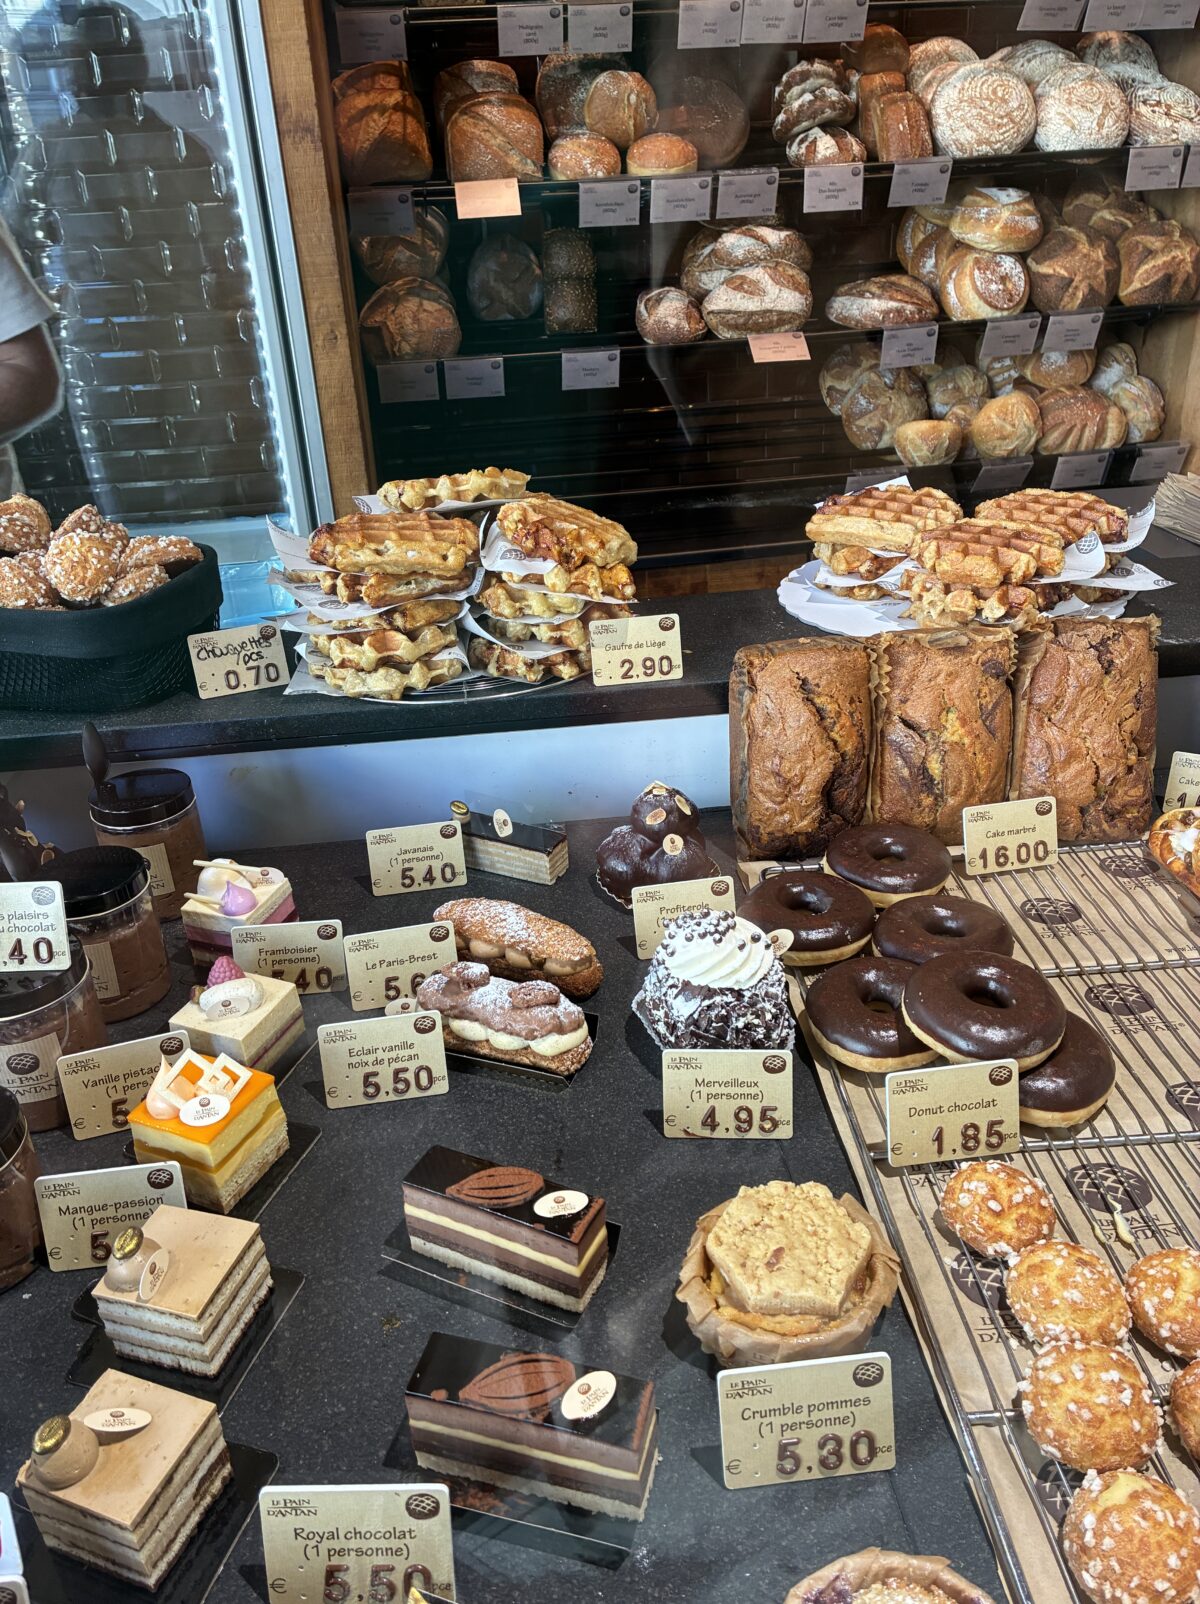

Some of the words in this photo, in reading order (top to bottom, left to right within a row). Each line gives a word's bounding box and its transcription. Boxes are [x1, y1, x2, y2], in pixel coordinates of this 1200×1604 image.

[605, 642, 632, 652] Gaufre
[646, 640, 666, 648] Liège
[620, 655, 672, 680] 2,90
[224, 662, 279, 690] 0,70
[1179, 777, 1200, 786] Cake
[986, 829, 1005, 838] Cake
[1007, 825, 1036, 836] marbré
[397, 844, 434, 856] Javanais
[979, 840, 1048, 868] 16,00
[389, 858, 398, 868] (1
[402, 852, 444, 866] personne)
[401, 862, 456, 888] 5,40
[660, 902, 710, 914] Profiterole
[8, 910, 48, 924] plaisirs
[8, 922, 56, 932] chocolat
[258, 946, 317, 956] Framboisier
[258, 959, 268, 968] (1
[272, 954, 320, 967] personne)
[366, 962, 376, 970] Le
[379, 952, 438, 968] Paris-Brest
[348, 1046, 380, 1058] Eclair
[382, 1041, 414, 1053] vanille
[348, 1060, 369, 1070] noix
[372, 1057, 384, 1066] de
[388, 1053, 419, 1068] pécan
[19, 1072, 48, 1084] PAIN
[82, 1074, 120, 1088] Vanille
[328, 1087, 338, 1098] €
[362, 1065, 433, 1098] 5,50
[433, 1075, 446, 1084] pce
[695, 1078, 758, 1088] Merveilleux
[904, 1078, 924, 1086] PAIN
[106, 1086, 118, 1098] (1
[690, 1090, 702, 1102] (1
[707, 1090, 764, 1102] personne)
[909, 1106, 944, 1117] Donut
[948, 1098, 998, 1112] chocolat
[73, 1118, 86, 1129] €
[665, 1115, 676, 1126] €
[702, 1105, 778, 1133] 4,95
[892, 1143, 902, 1155] €
[932, 1119, 1004, 1155] 1,85
[1004, 1132, 1018, 1142] pce
[58, 1196, 164, 1216] Mangue-passion
[72, 1216, 85, 1230] (1
[91, 1208, 154, 1228] personne)
[49, 1247, 62, 1260] €
[741, 1379, 766, 1388] PAIN
[726, 1388, 772, 1400] D'ANTAN
[741, 1402, 803, 1421] Crumble
[808, 1396, 871, 1414] pommes
[758, 1422, 773, 1438] (1
[780, 1412, 856, 1436] personne)
[726, 1459, 742, 1474] €
[776, 1430, 875, 1474] 5,30
[874, 1444, 892, 1458] pce
[267, 1508, 318, 1518] D'ANTAN
[294, 1527, 340, 1542] Royal
[344, 1526, 416, 1540] chocolat
[304, 1544, 320, 1560] (1
[328, 1544, 410, 1562] personne)
[270, 1578, 287, 1594] €
